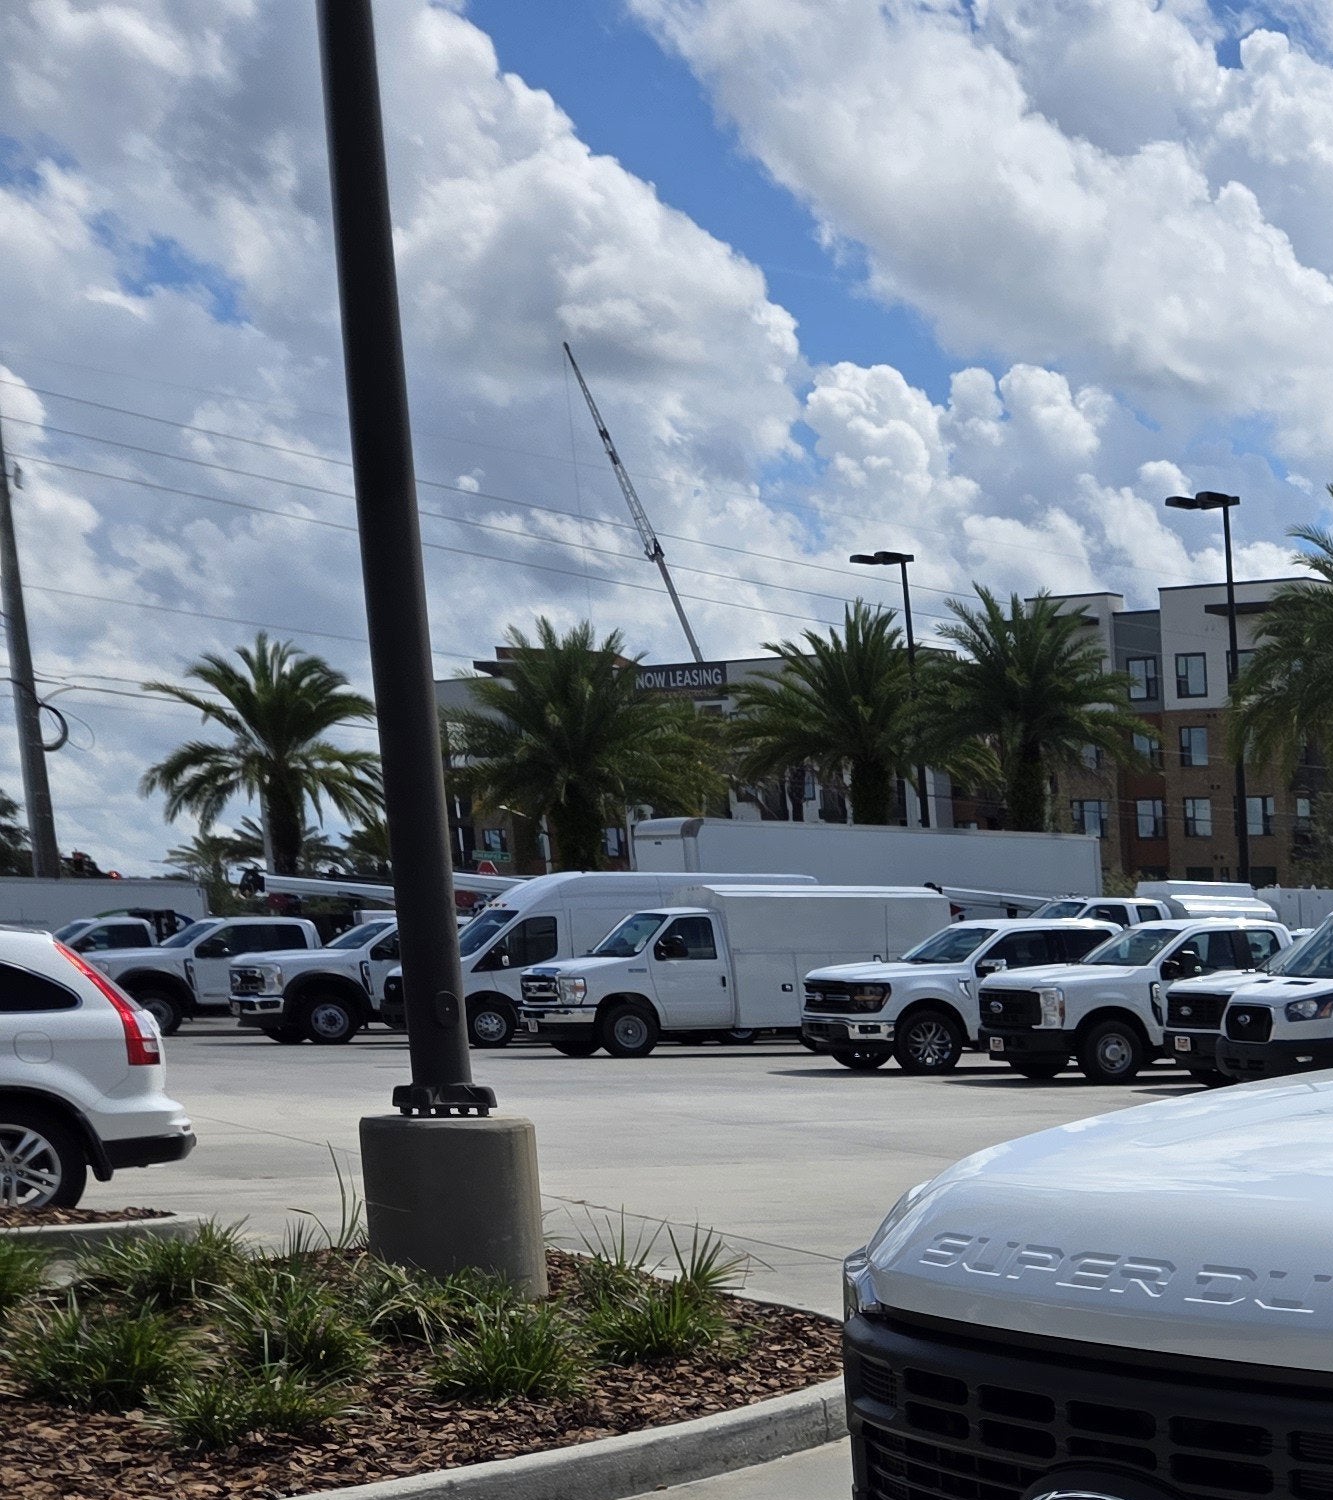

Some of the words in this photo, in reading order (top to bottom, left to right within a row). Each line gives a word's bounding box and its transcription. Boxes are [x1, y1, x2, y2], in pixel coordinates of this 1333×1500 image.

[636, 671, 665, 690] NOW
[669, 668, 722, 687] LEASING
[918, 1232, 1177, 1297] SUPER
